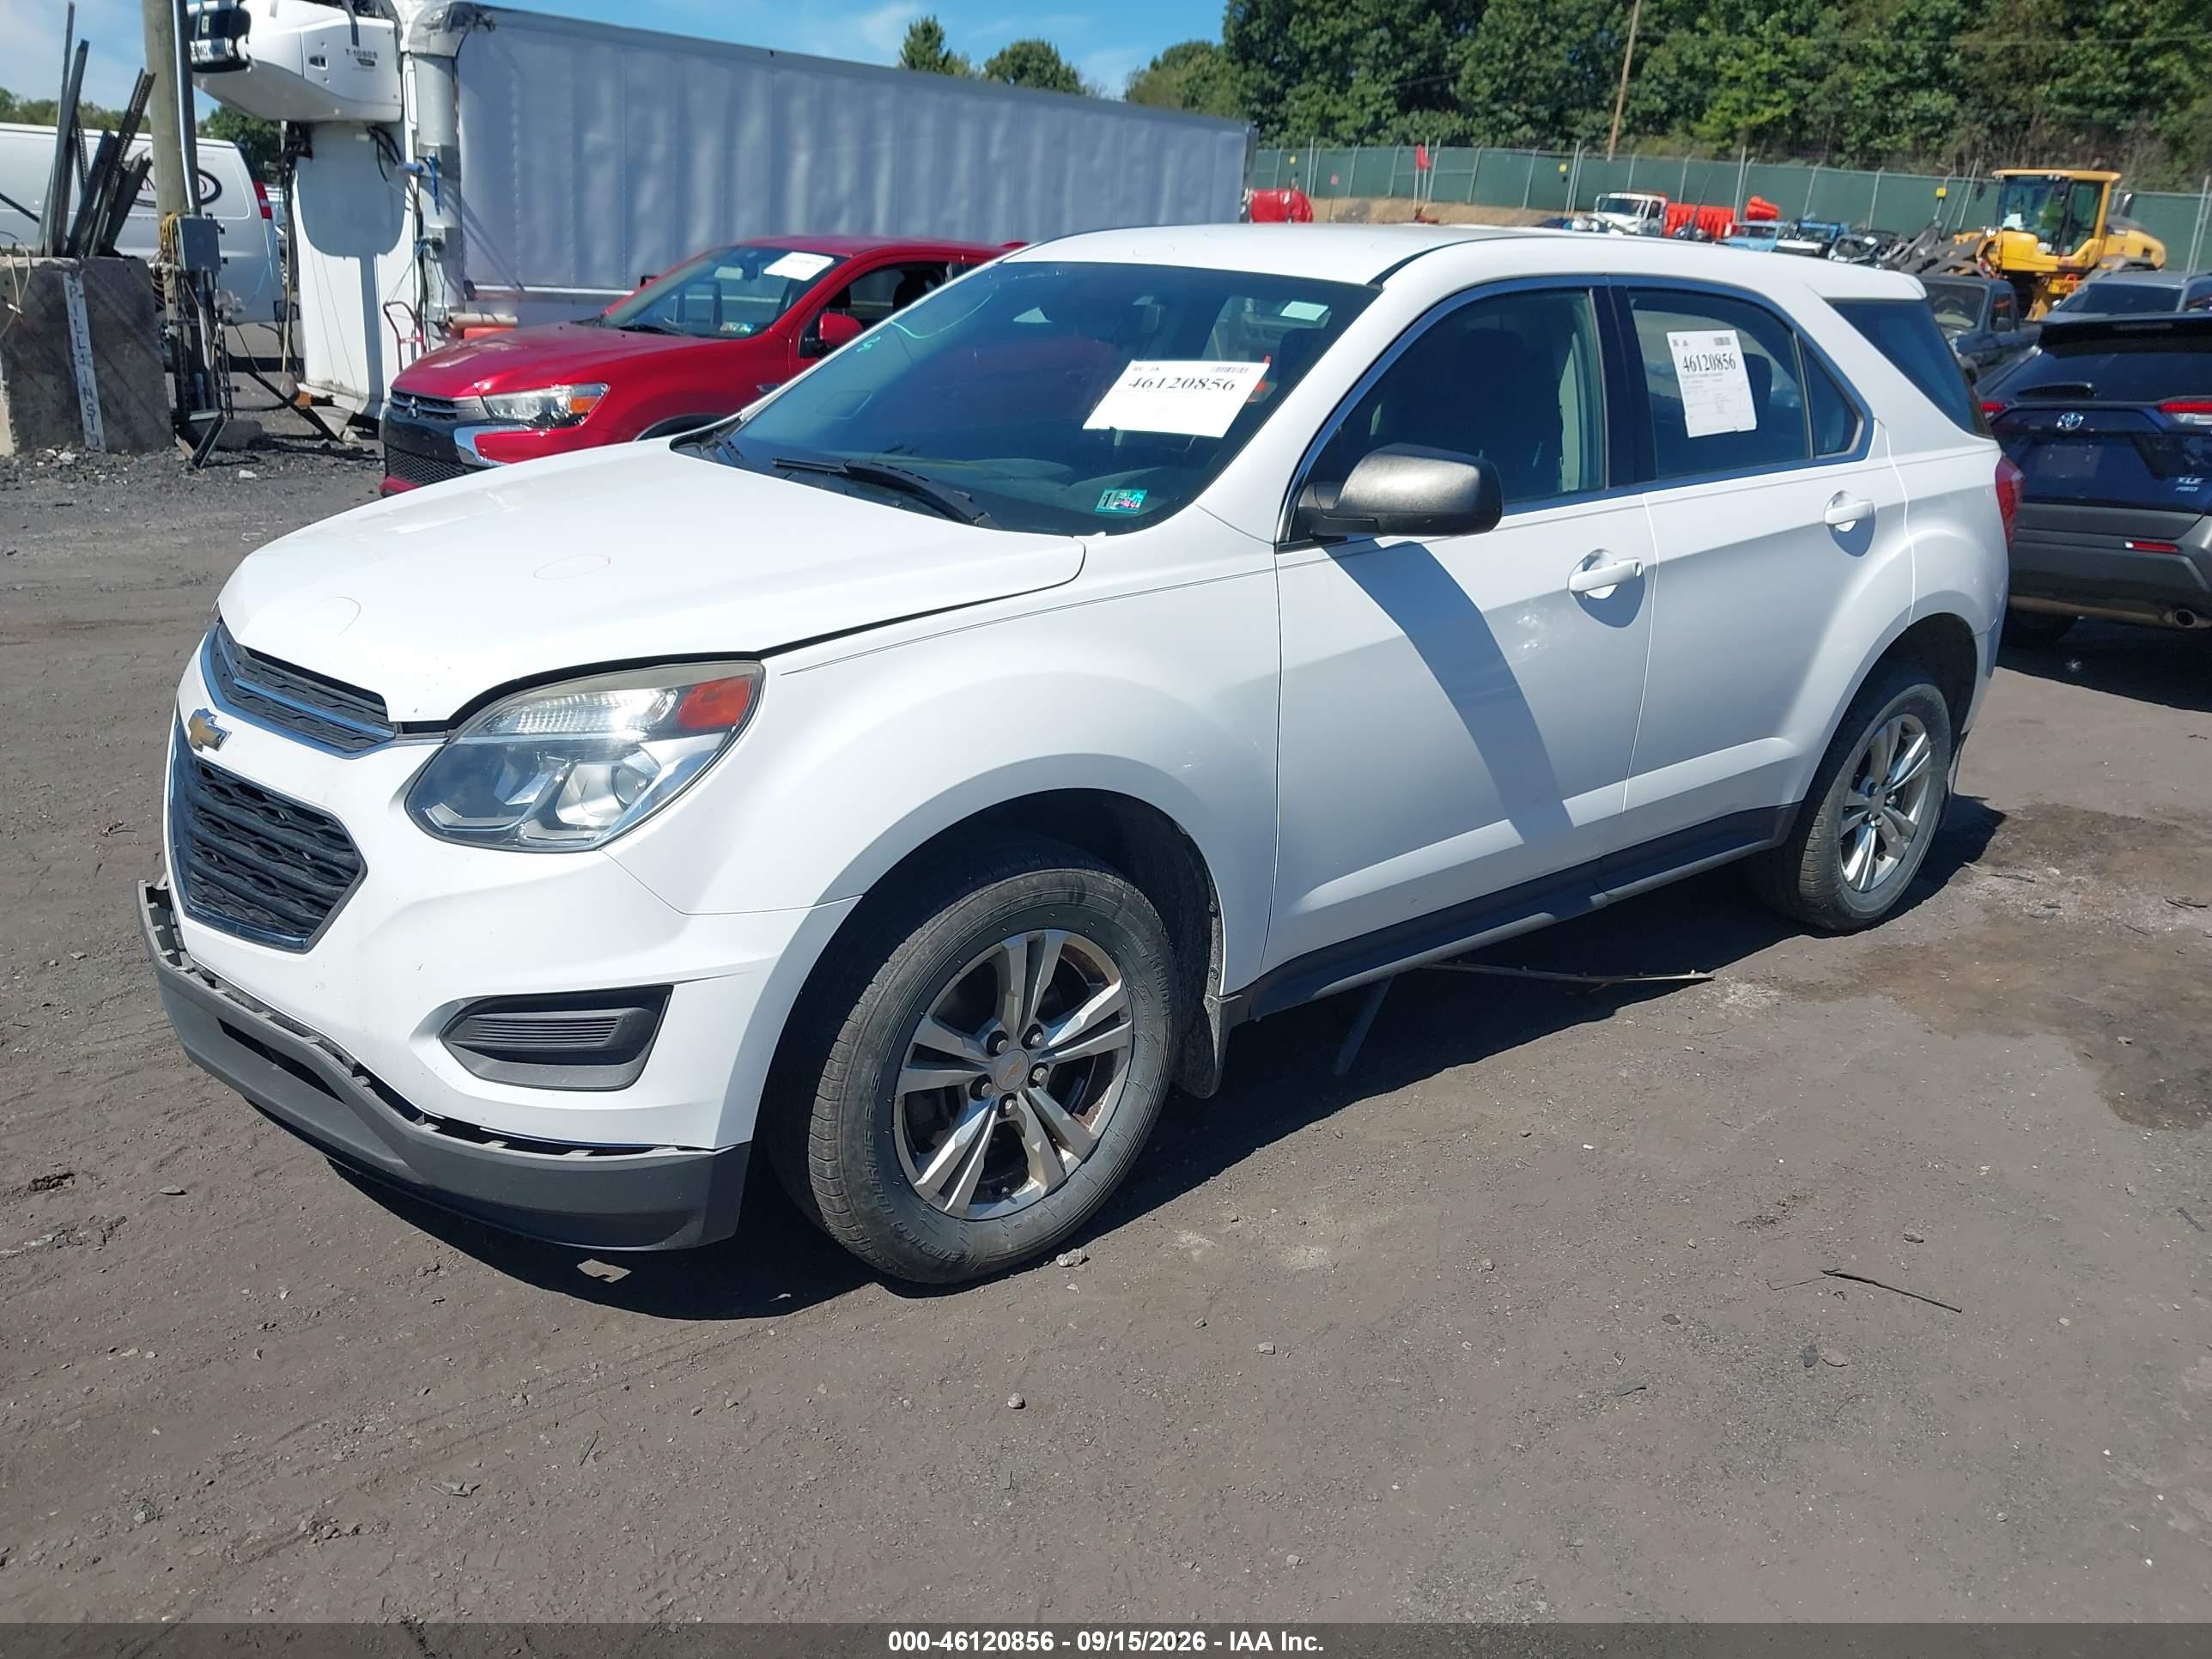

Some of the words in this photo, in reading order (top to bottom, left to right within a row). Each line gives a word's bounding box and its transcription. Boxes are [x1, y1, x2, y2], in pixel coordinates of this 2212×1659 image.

[1683, 353, 1736, 372] 46120856
[1128, 377, 1237, 392] 46120856
[1149, 952, 1171, 1017] KENDA
